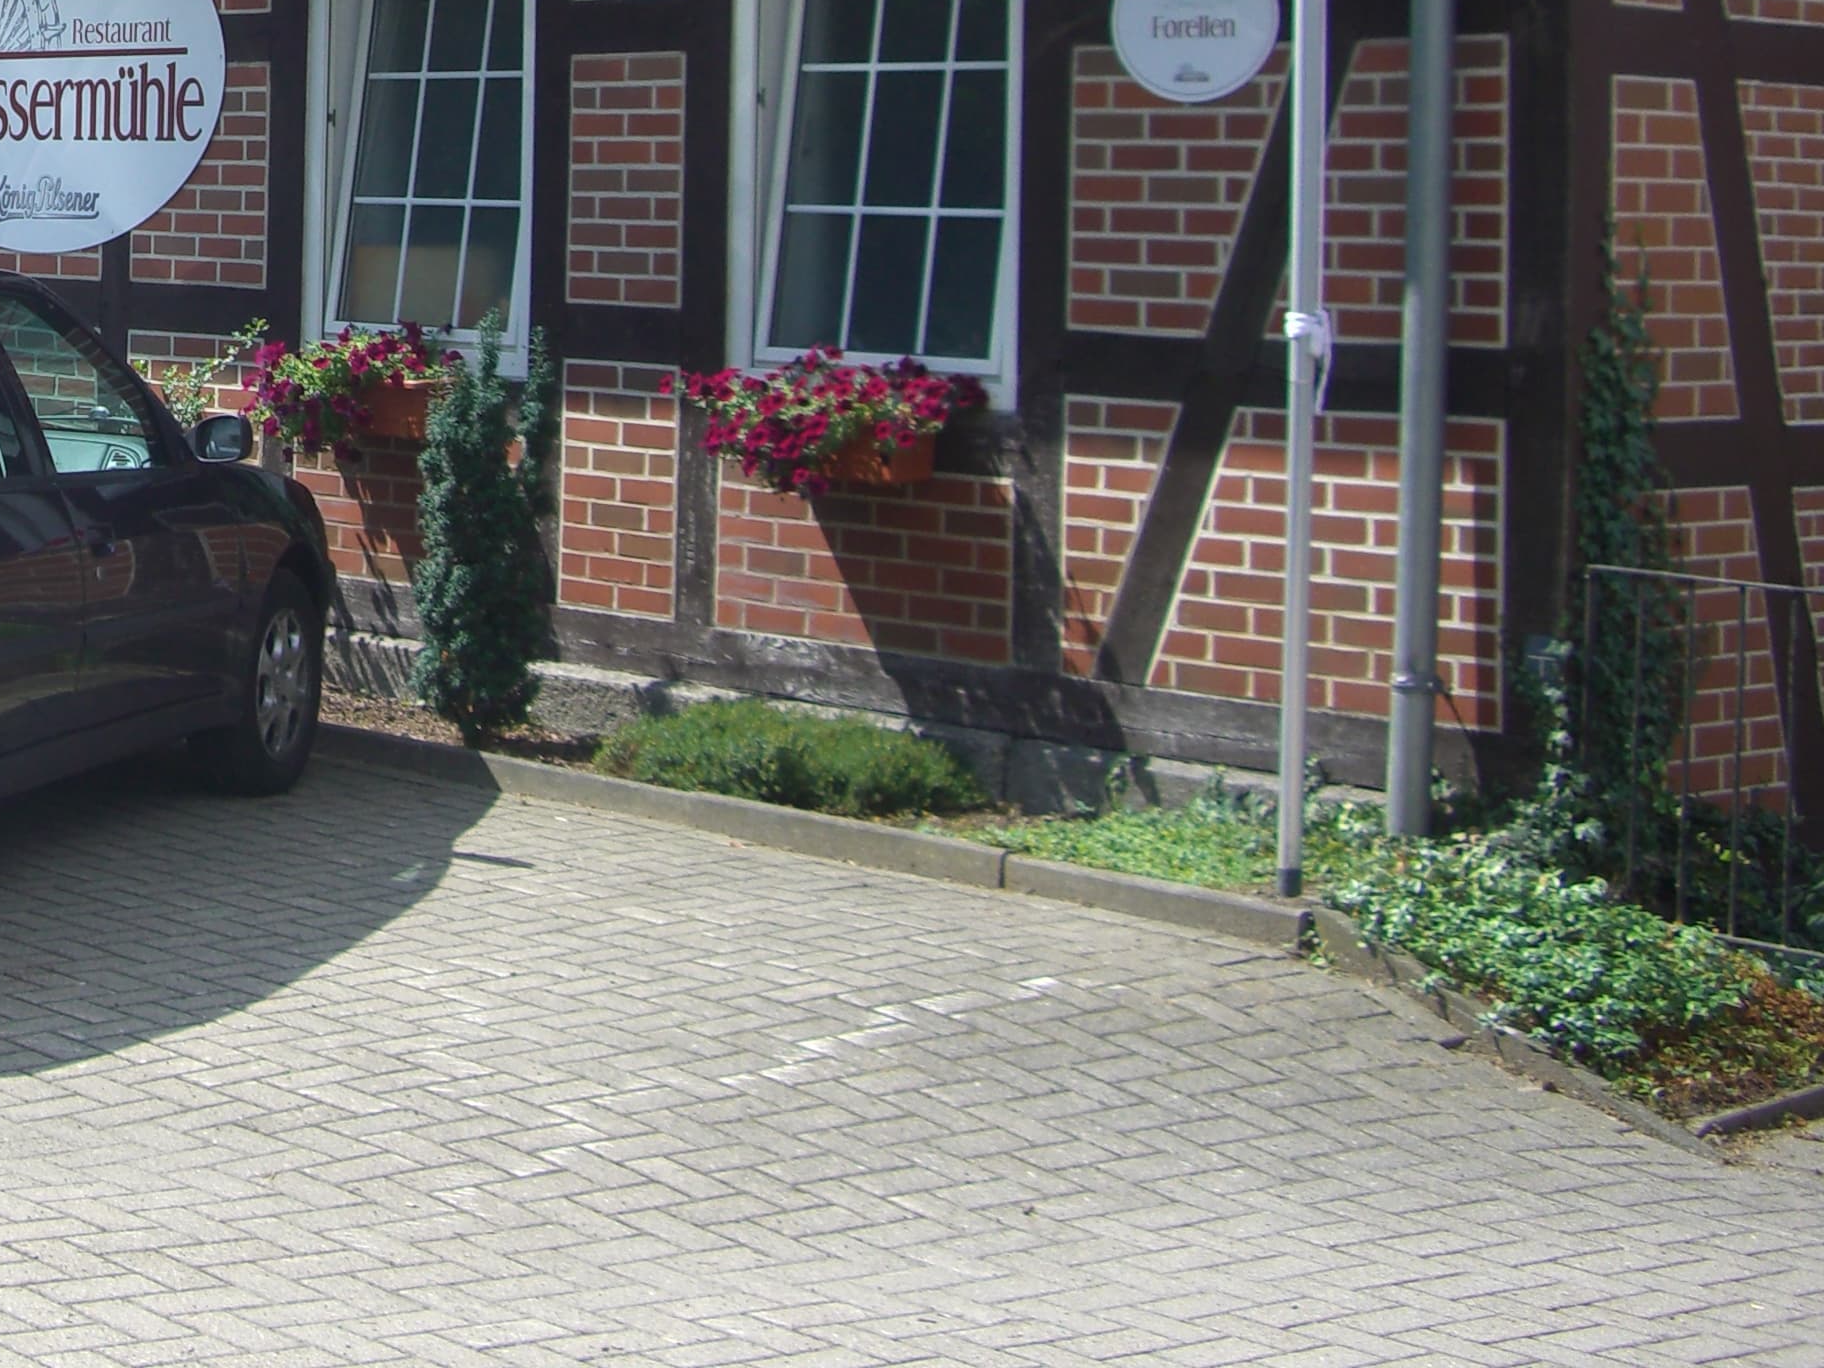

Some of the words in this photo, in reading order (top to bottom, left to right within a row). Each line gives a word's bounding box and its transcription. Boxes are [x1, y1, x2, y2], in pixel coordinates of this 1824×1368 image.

[72, 17, 172, 45] Restaurant
[1152, 15, 1235, 39] Forellen
[36, 175, 100, 215] Pilsener
